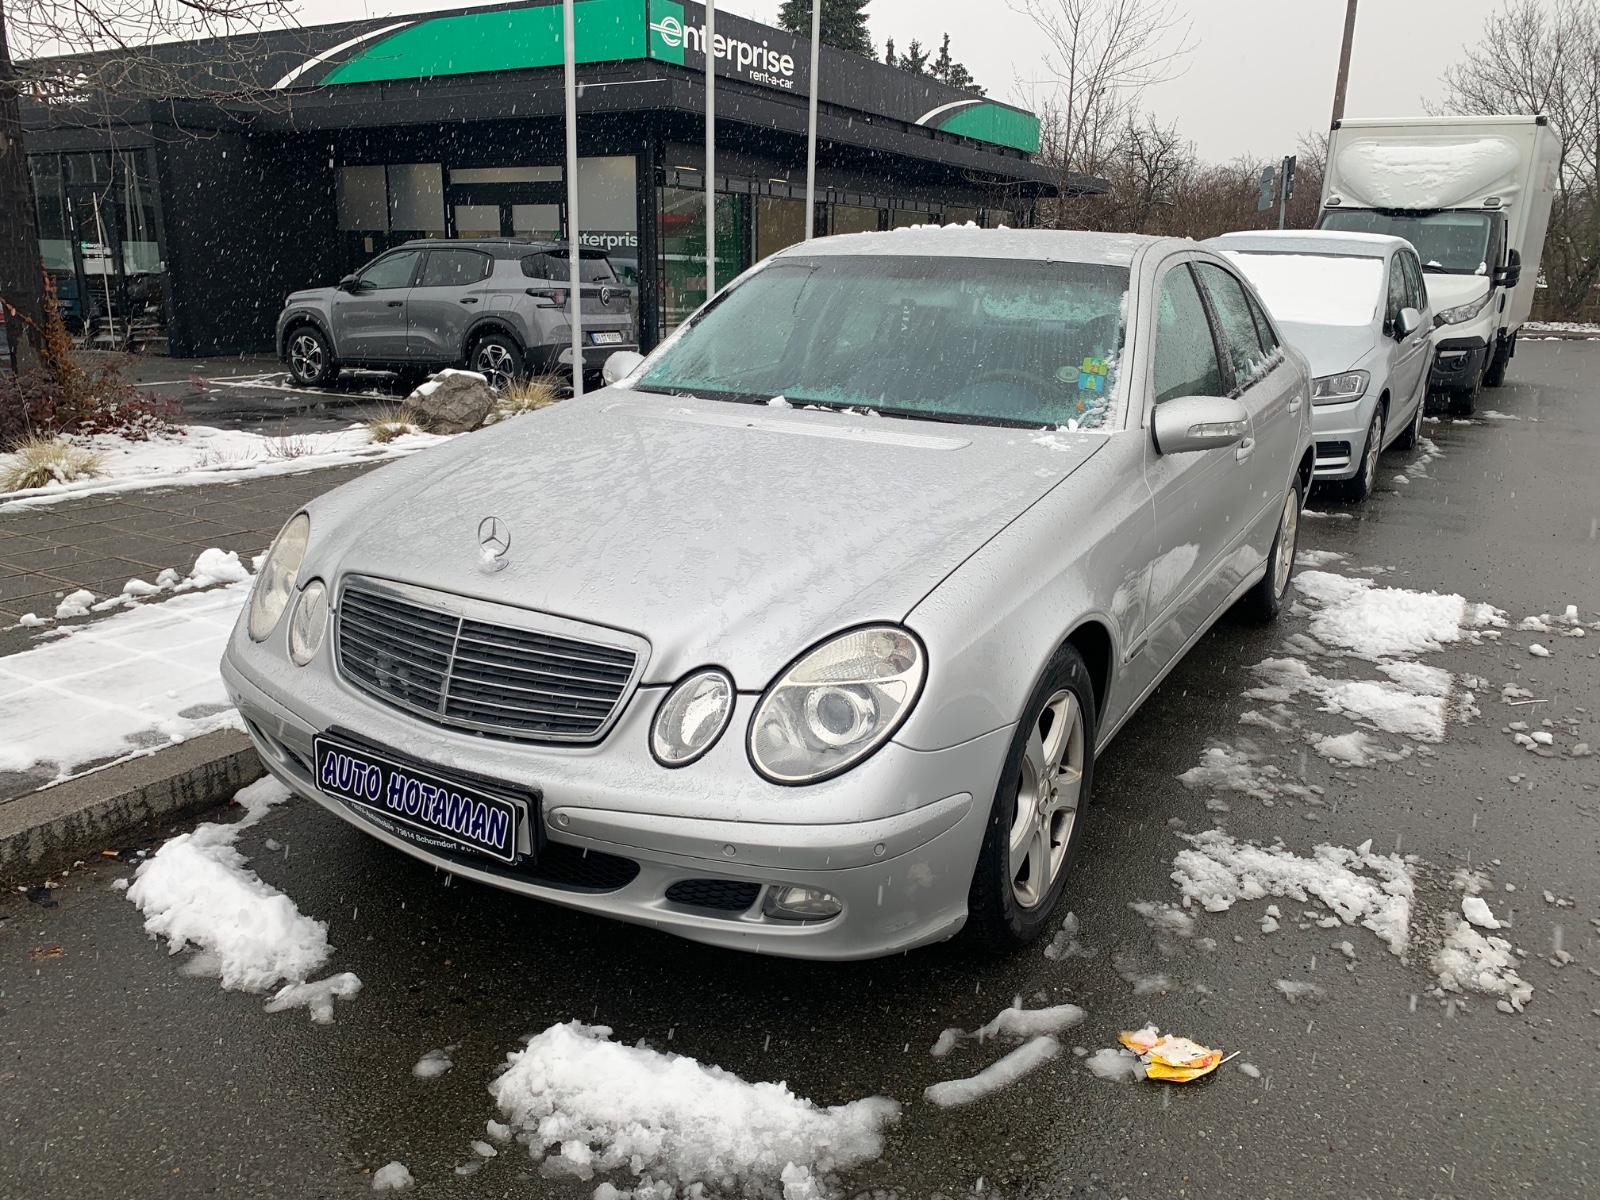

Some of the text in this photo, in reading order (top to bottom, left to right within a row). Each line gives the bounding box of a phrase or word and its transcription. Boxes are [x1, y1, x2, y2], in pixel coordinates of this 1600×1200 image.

[750, 69, 794, 89] rent-a-car
[322, 751, 509, 849] AUTO HOTAMAN
